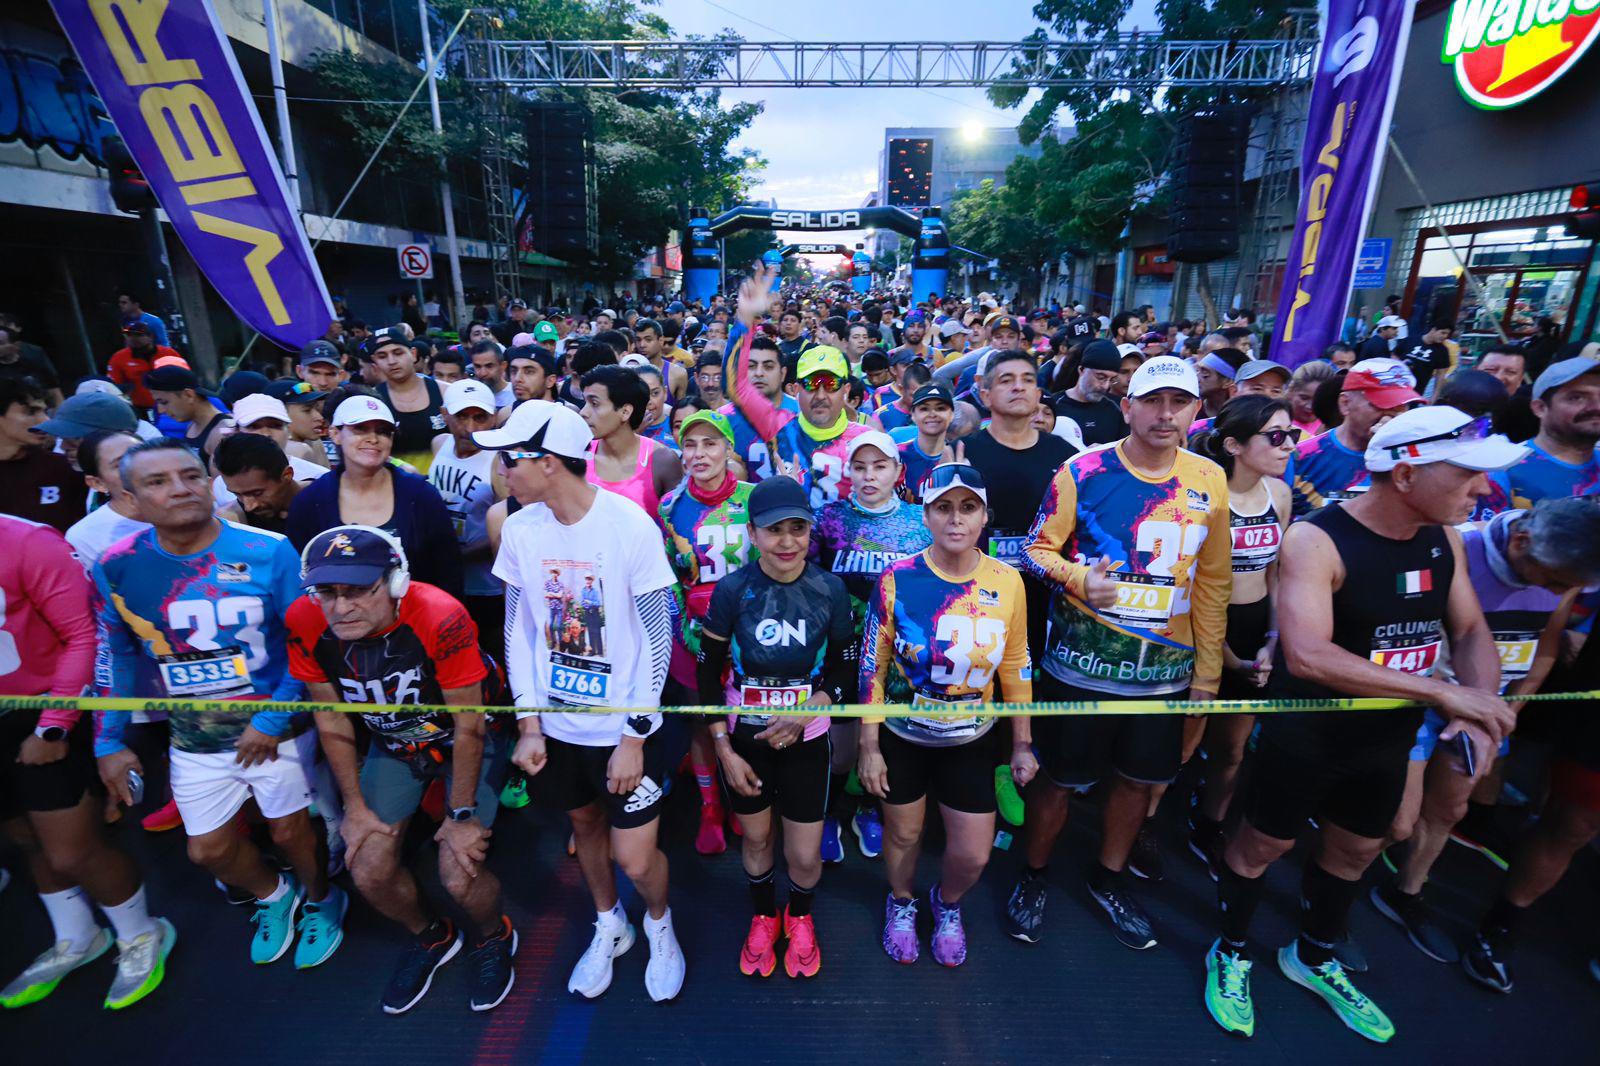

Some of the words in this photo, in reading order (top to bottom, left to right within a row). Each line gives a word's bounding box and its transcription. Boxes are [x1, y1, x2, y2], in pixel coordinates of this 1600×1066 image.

[771, 211, 861, 228] SALIDA
[799, 244, 836, 253] SALIDA
[434, 464, 482, 502] NIKE
[39, 486, 60, 504] B
[1244, 527, 1274, 547] 073
[1117, 586, 1159, 607] 970
[755, 618, 806, 647] ON
[931, 614, 1007, 689] 33
[1386, 649, 1427, 670] 441
[171, 660, 236, 684] 3535
[554, 669, 602, 695] 3766
